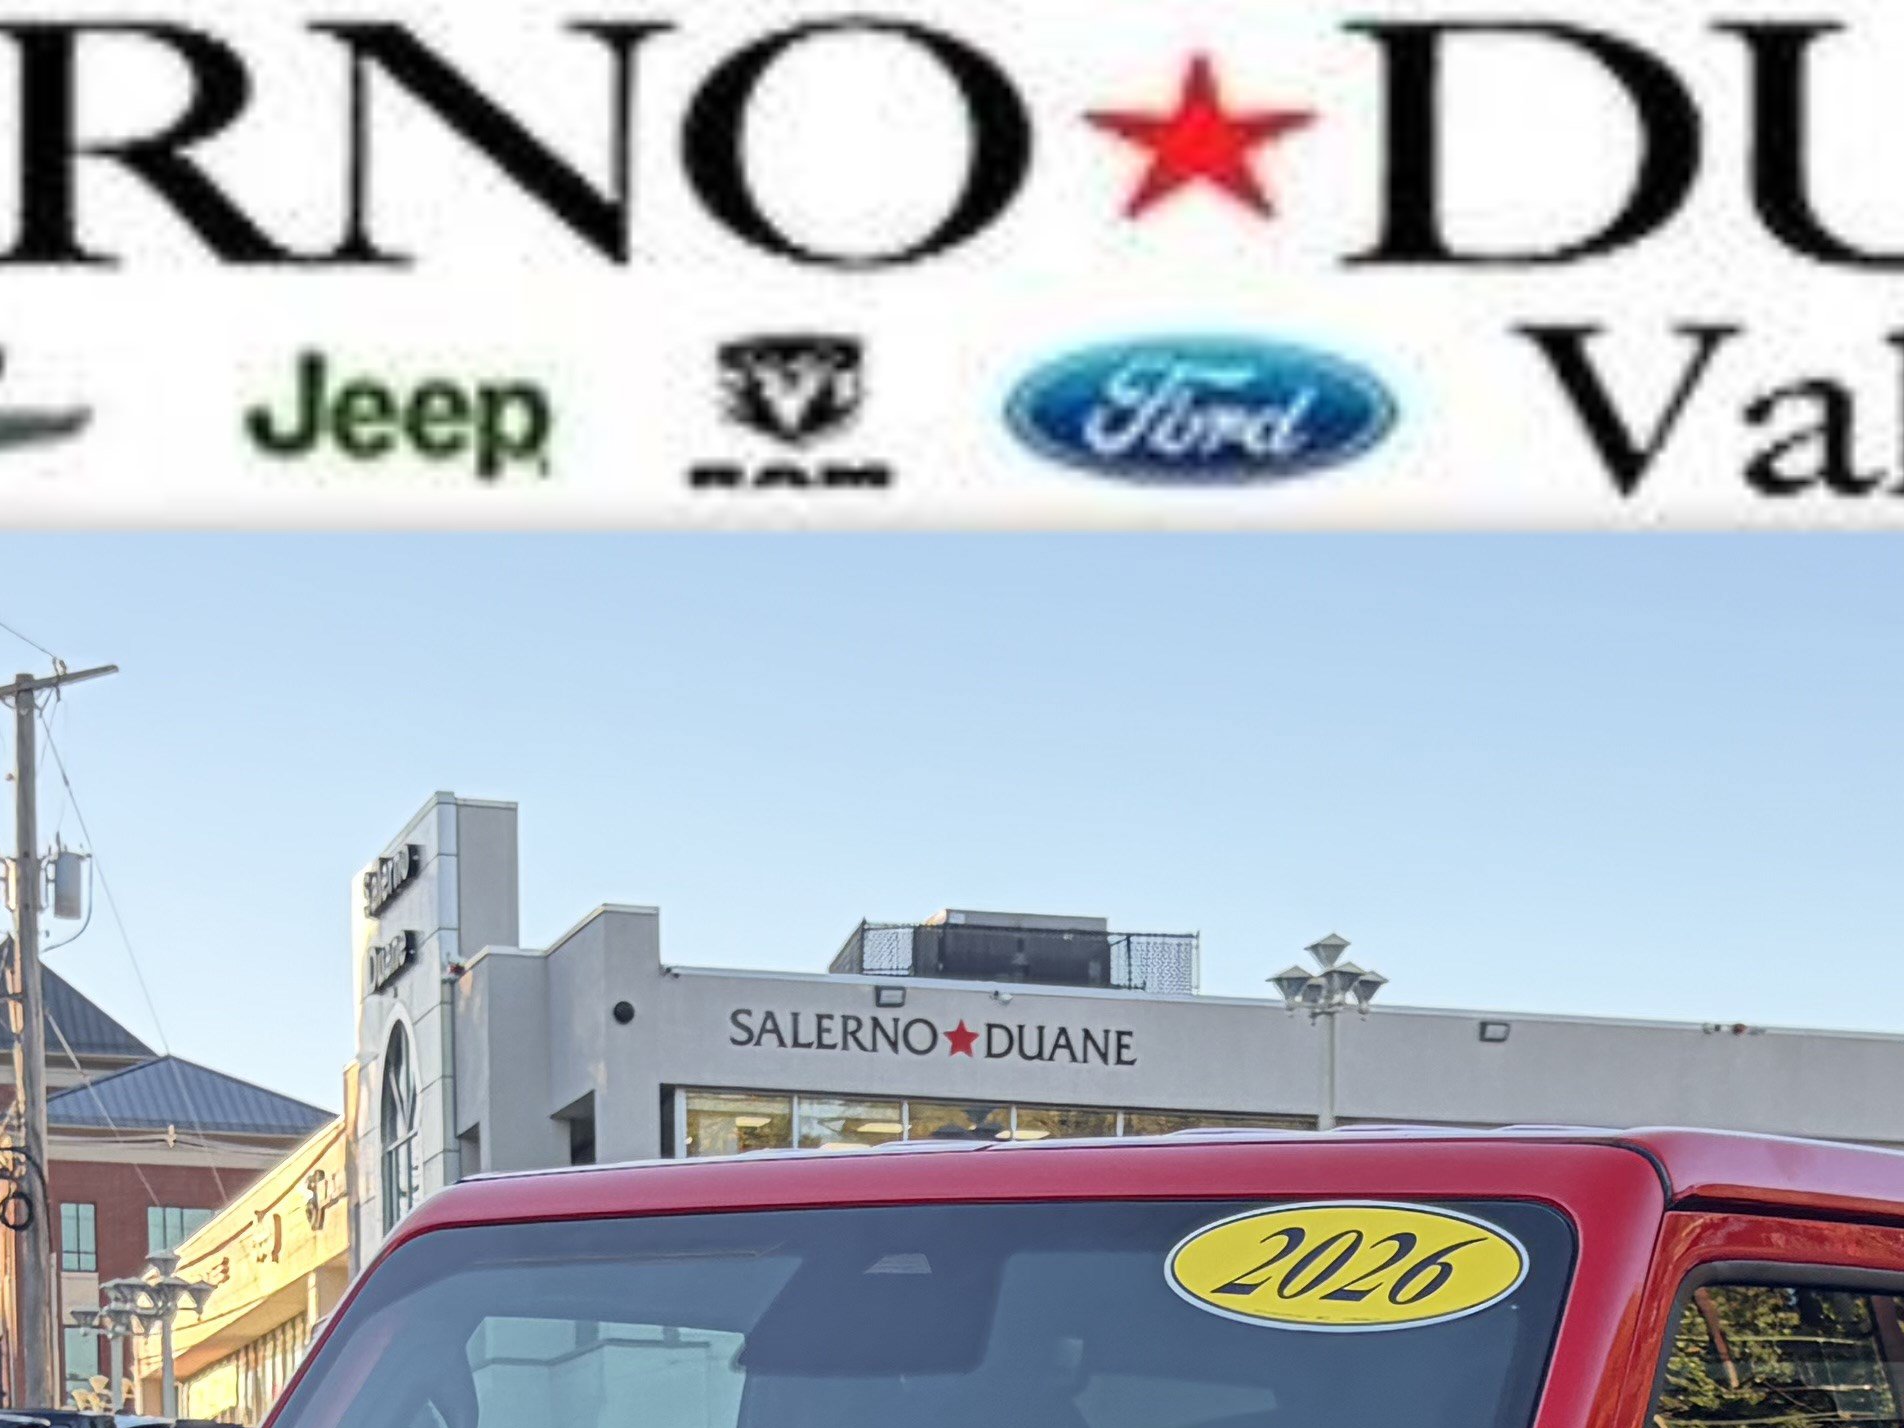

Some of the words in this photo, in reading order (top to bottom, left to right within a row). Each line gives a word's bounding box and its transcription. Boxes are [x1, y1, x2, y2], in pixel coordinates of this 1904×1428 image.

[729, 1008, 939, 1056] SALERNO
[984, 1022, 1137, 1067] DUANE
[1209, 1226, 1489, 1306] 2026
